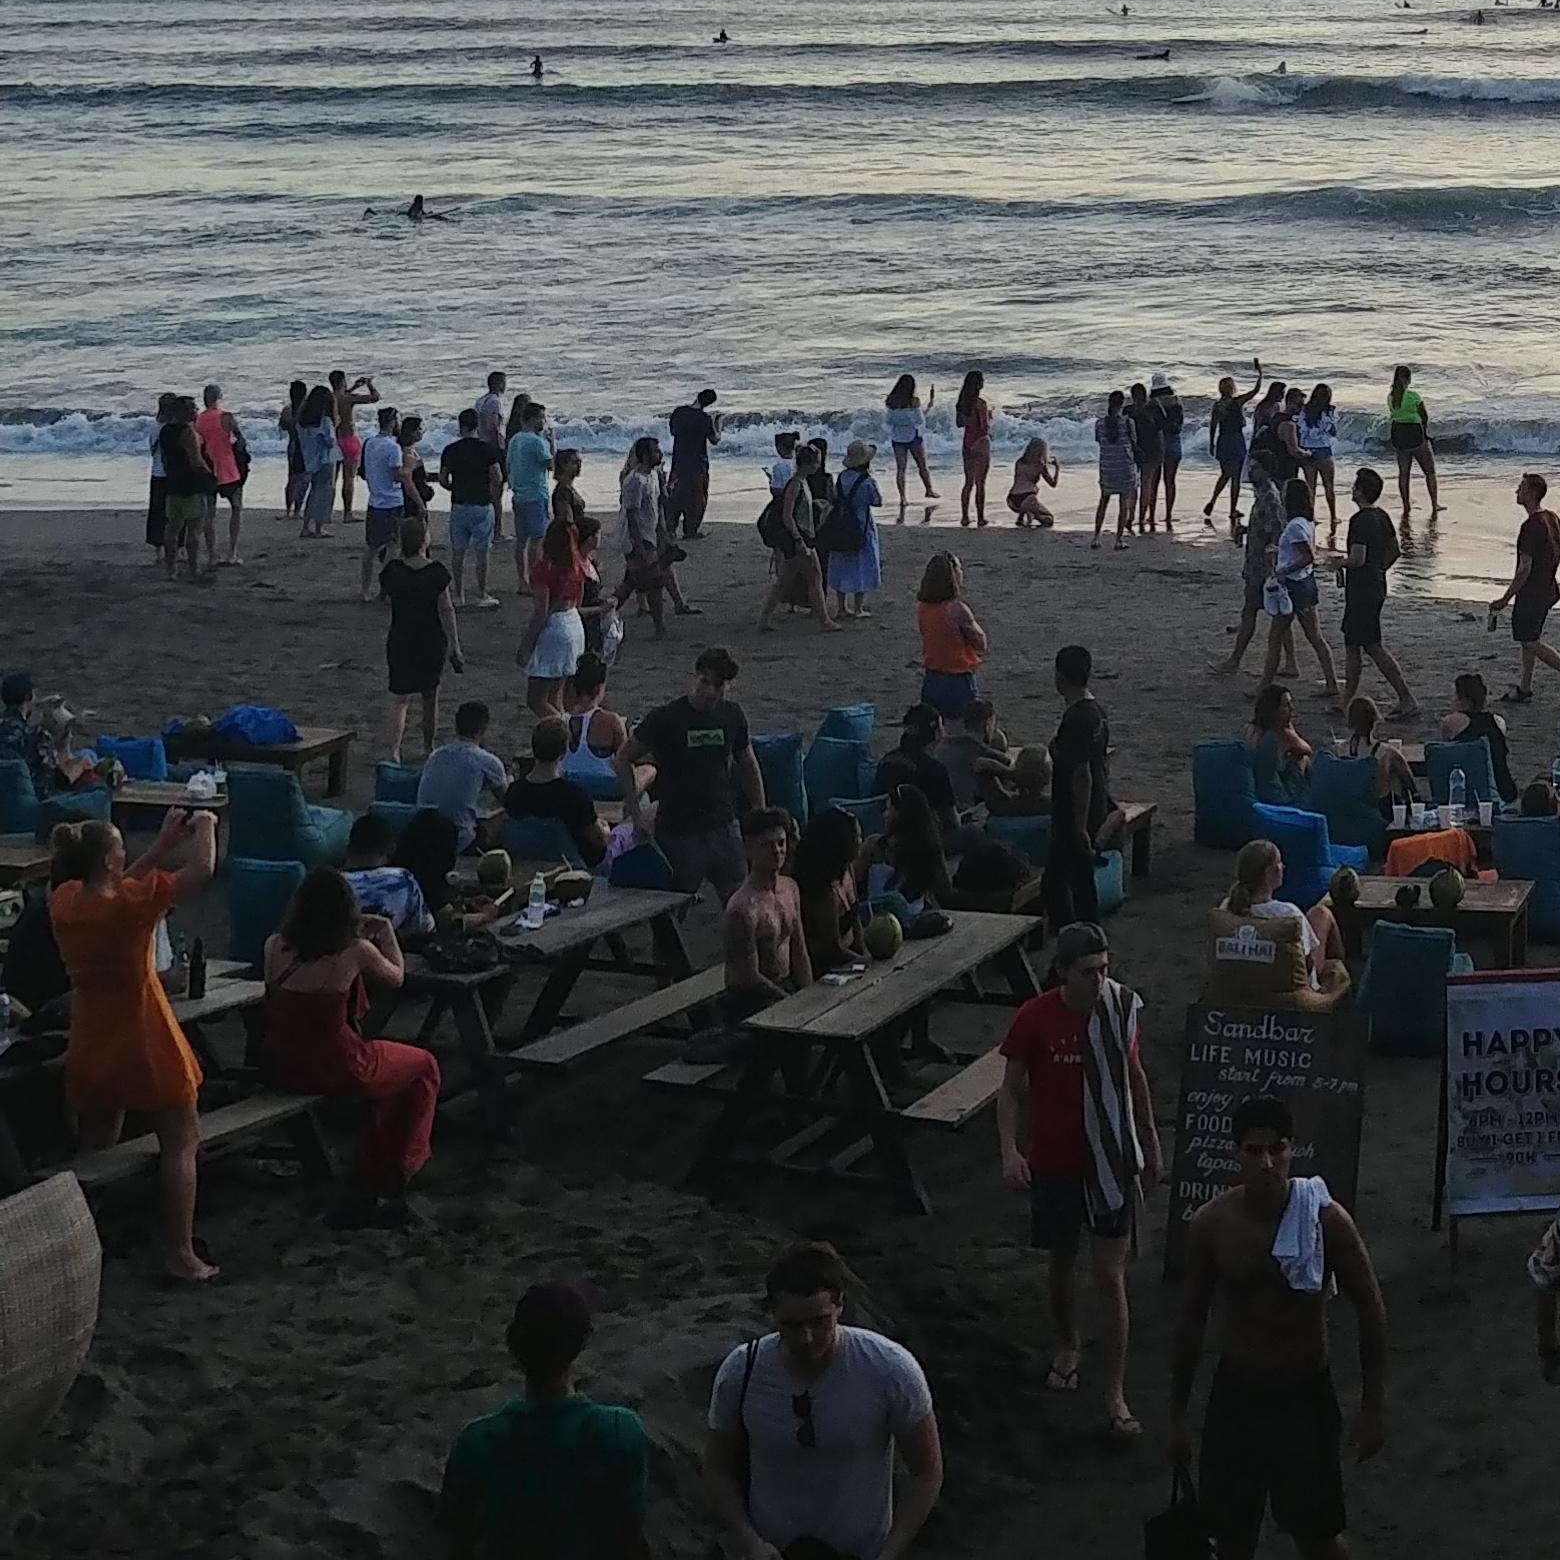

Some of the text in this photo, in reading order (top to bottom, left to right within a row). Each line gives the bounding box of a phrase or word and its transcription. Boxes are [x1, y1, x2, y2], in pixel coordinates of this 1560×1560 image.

[1204, 1010, 1315, 1044] Sandbar
[1190, 1043, 1312, 1069] LIFE MUSIC
[1218, 1065, 1260, 1082] start
[1259, 1071, 1306, 1092] from
[1186, 1090, 1233, 1113] enjoy
[1185, 1113, 1233, 1133] FOOD
[1519, 1111, 1558, 1125] 12PM
[1185, 1137, 1234, 1154] pizza
[1503, 1131, 1532, 1145] GET
[1197, 1152, 1242, 1177] tapas
